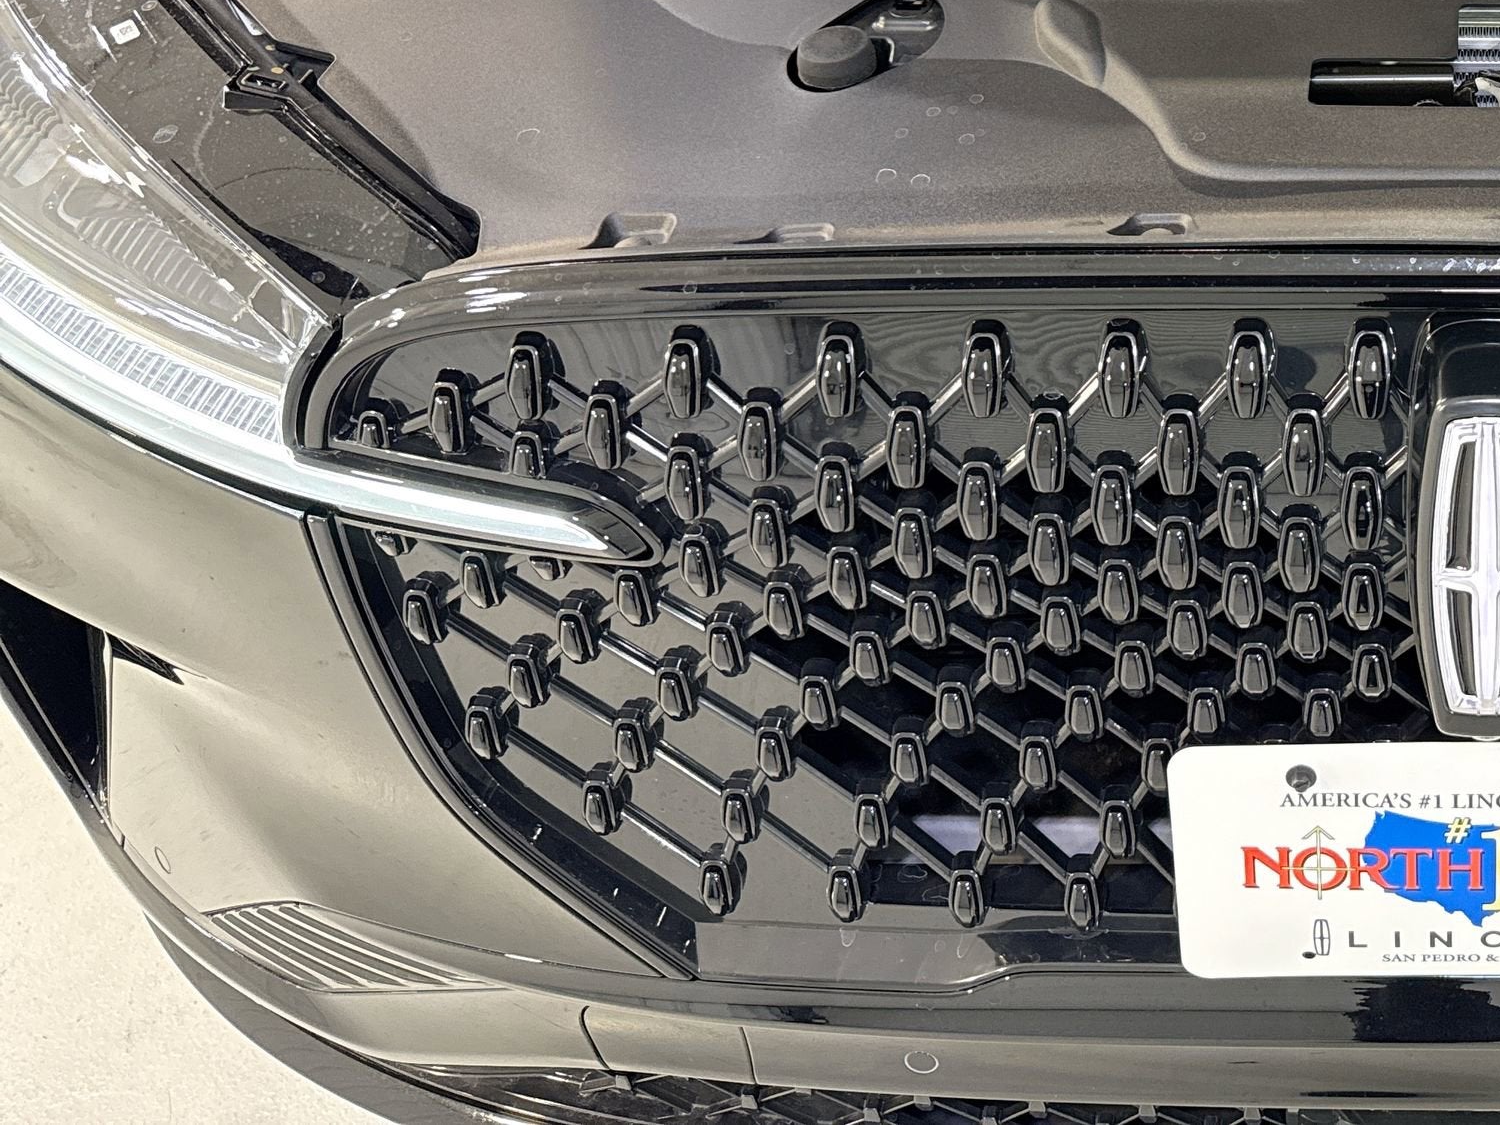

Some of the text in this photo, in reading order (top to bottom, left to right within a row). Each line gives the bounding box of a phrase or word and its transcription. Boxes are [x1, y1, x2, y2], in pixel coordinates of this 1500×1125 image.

[1280, 792, 1412, 809] AMERICA'S
[1418, 792, 1443, 809] #1
[1240, 845, 1484, 892] NORTH
[1382, 953, 1415, 963] SAN
[1421, 953, 1481, 963] PEDRO
[1485, 953, 1500, 963] &
